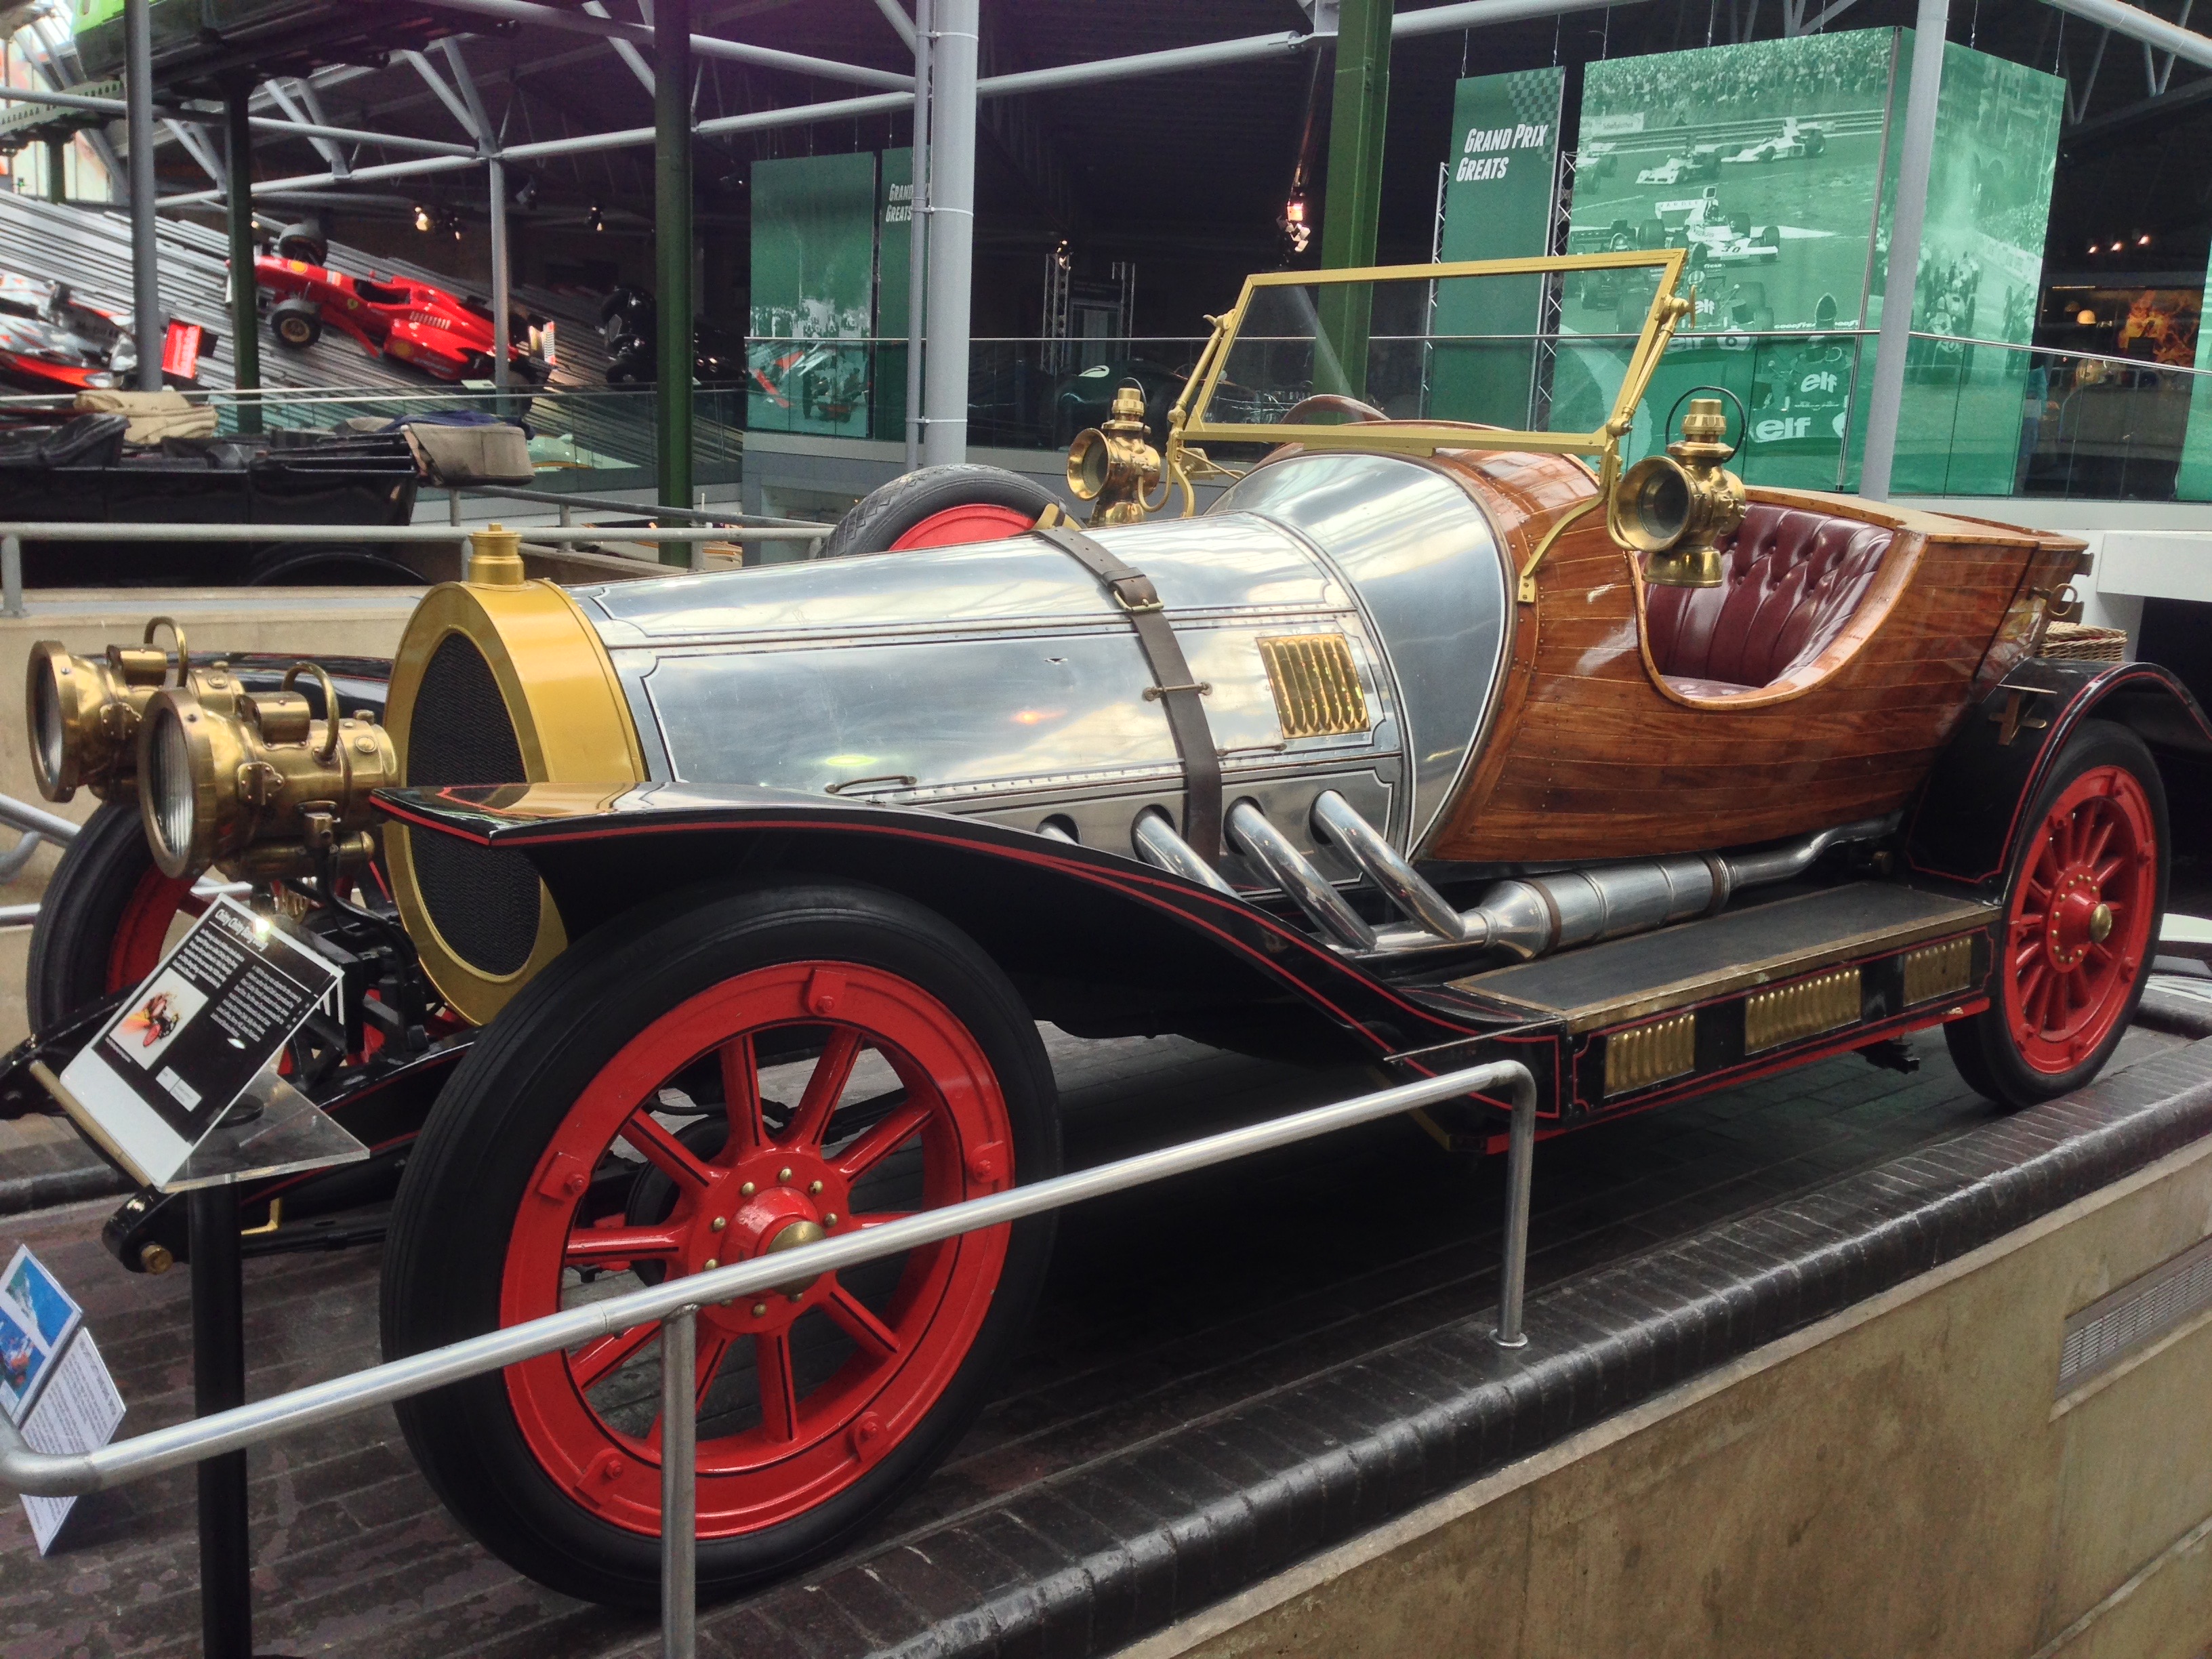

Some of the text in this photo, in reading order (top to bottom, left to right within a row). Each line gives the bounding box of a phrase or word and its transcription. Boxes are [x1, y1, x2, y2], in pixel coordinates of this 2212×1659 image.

[1464, 123, 1549, 153] GRAND PRIX
[1456, 157, 1509, 182] GREATS
[885, 205, 912, 222] GREATS
[1800, 371, 1837, 393] elf
[1755, 415, 1811, 441] elf
